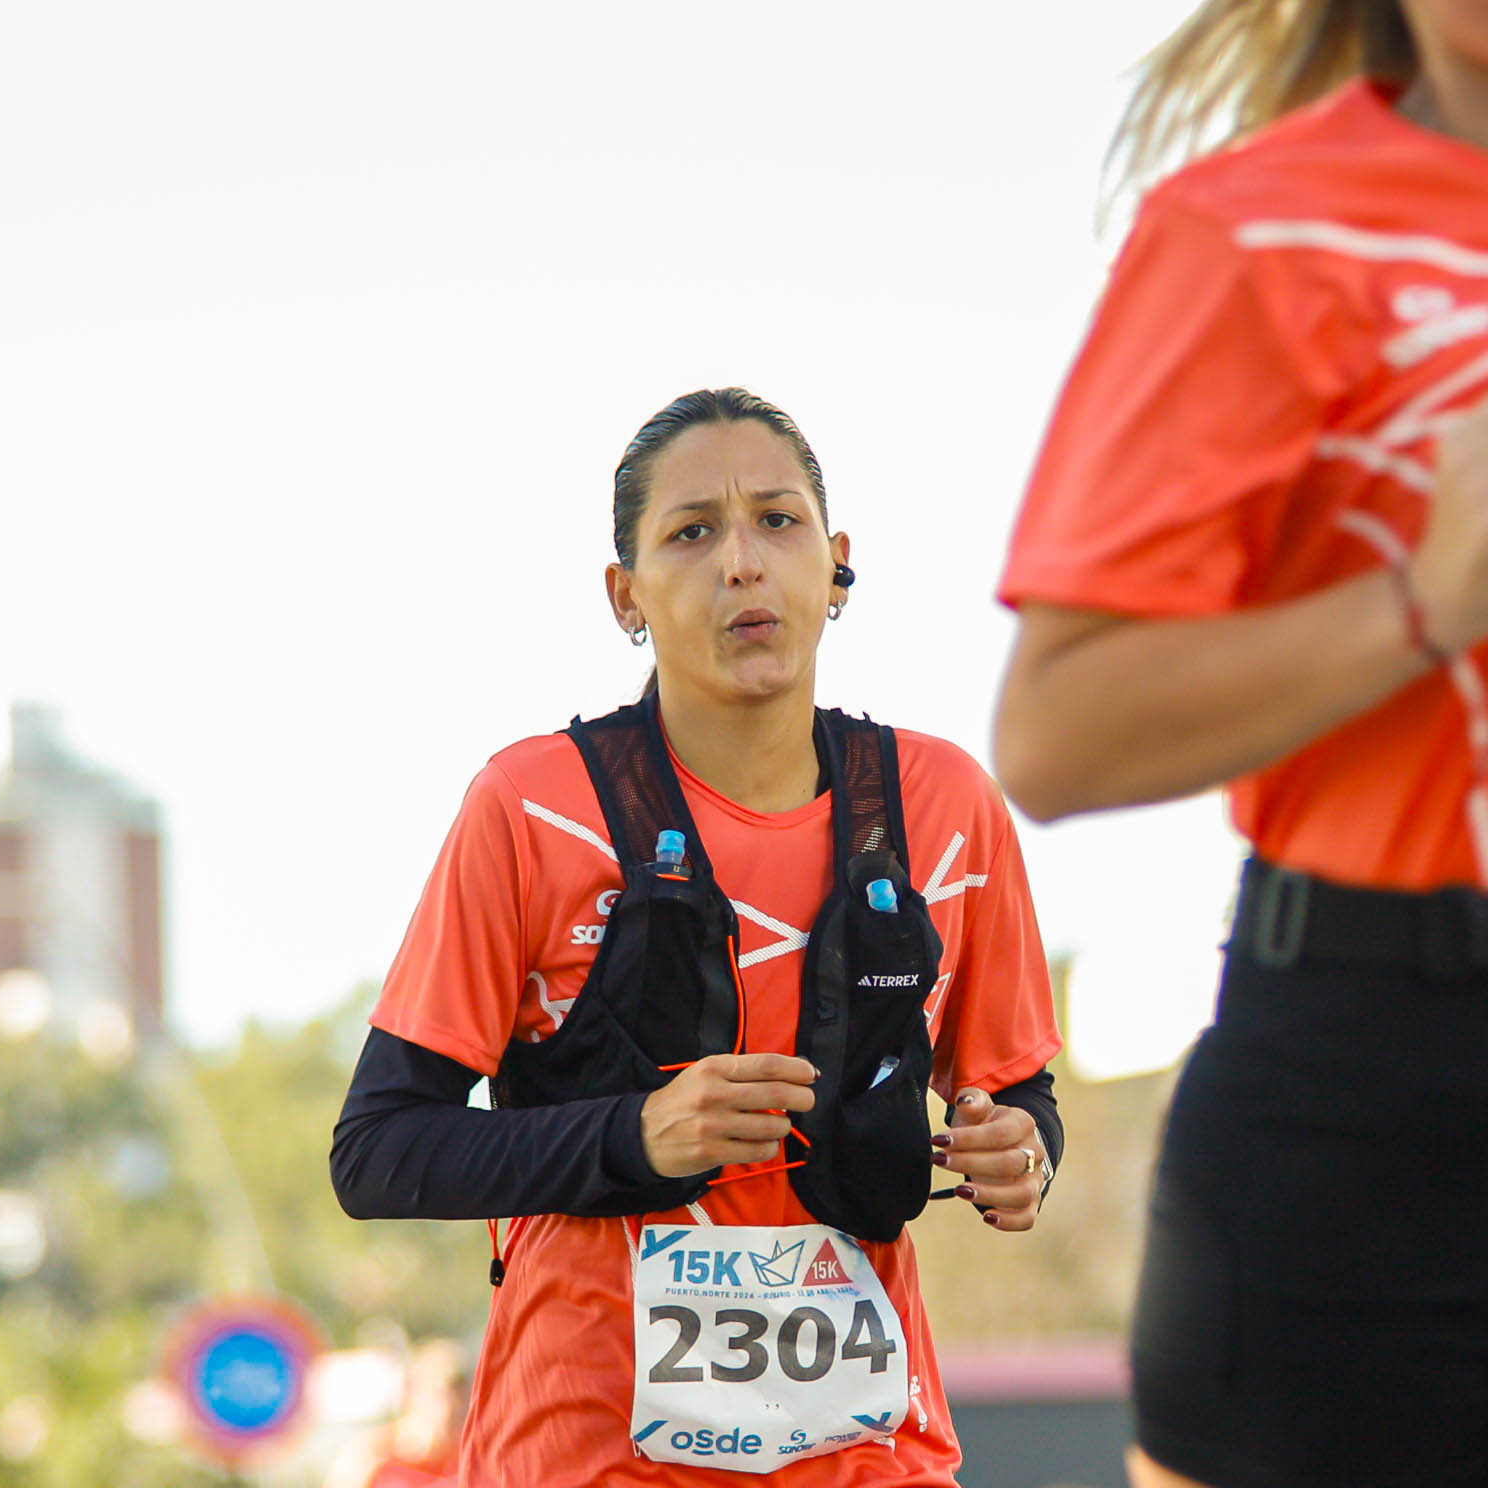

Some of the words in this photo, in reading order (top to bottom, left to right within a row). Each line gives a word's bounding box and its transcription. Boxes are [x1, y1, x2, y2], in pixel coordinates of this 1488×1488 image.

[872, 974, 919, 987] TERREX
[668, 1250, 742, 1287] 15K
[812, 1260, 840, 1280] 15K
[648, 1299, 896, 1383] 2304
[670, 1427, 762, 1455] osde
